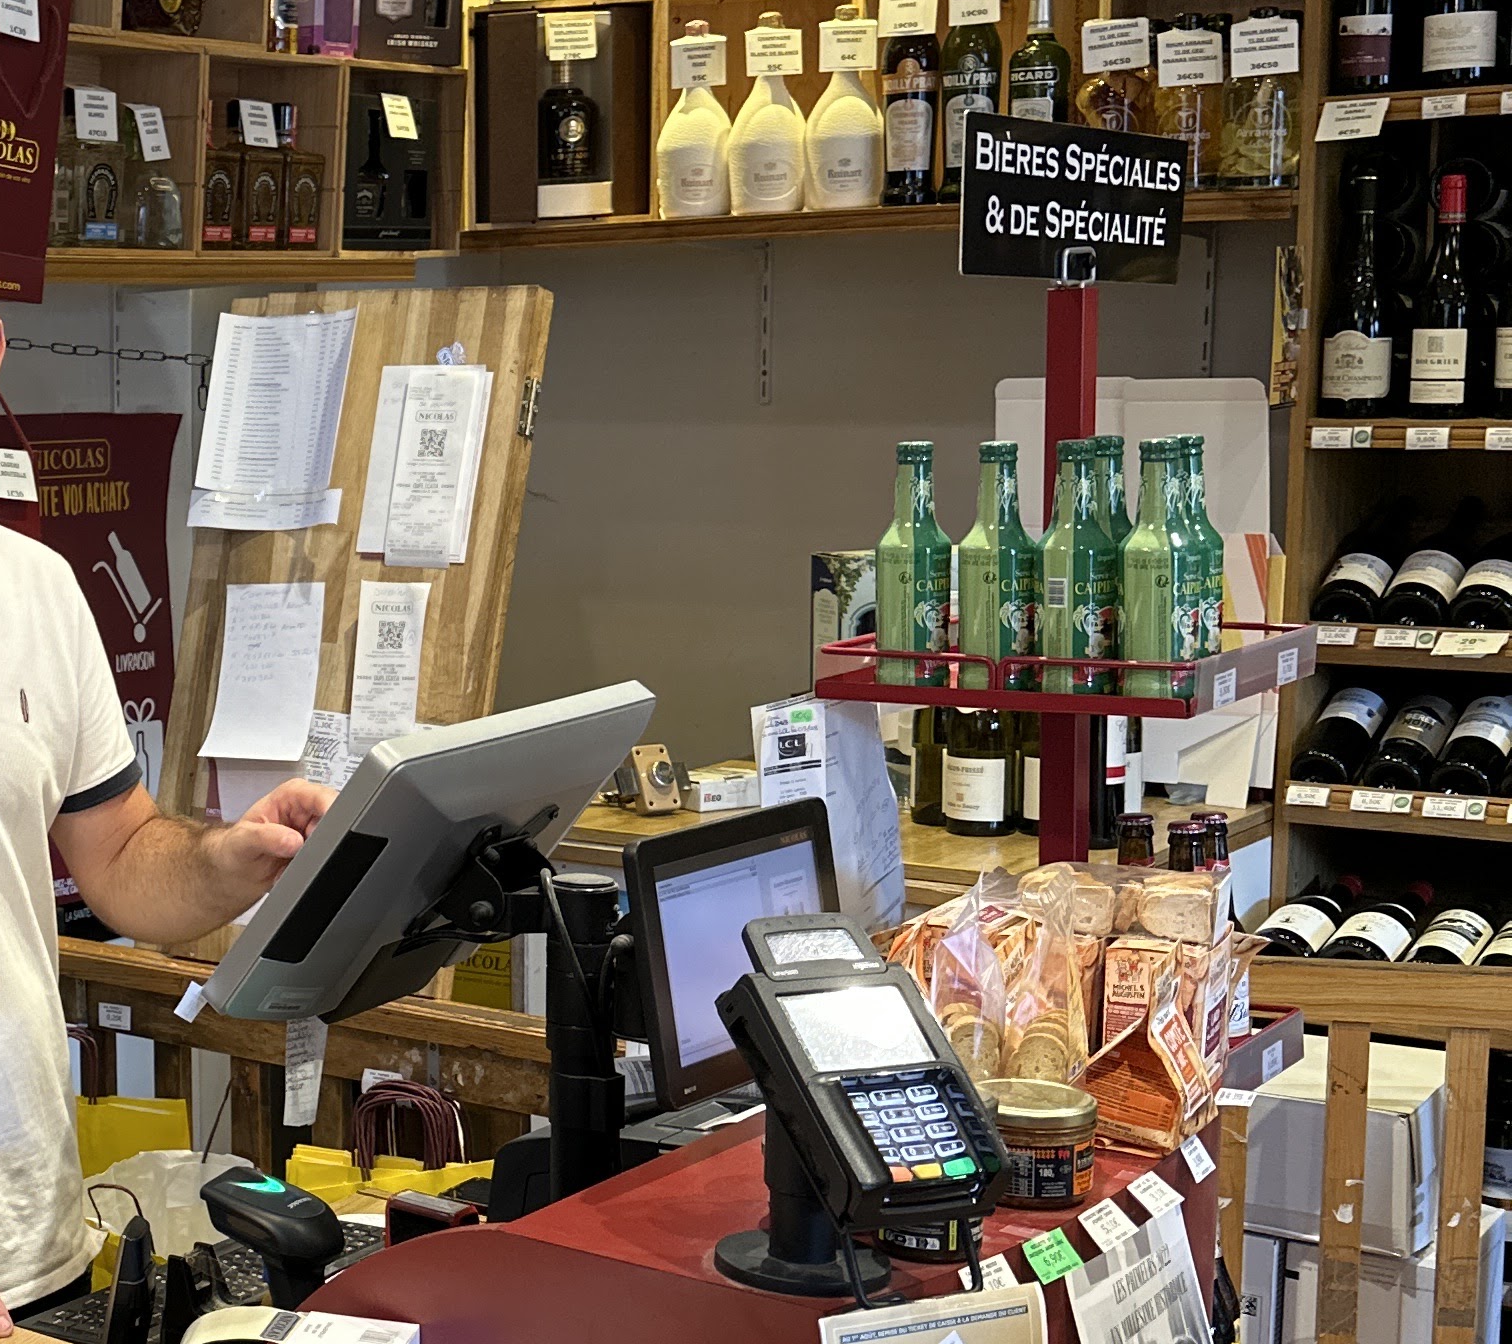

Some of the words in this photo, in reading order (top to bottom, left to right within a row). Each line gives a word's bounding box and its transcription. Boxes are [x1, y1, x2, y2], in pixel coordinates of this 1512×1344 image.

[975, 130, 1060, 179] BIÈRES
[1064, 143, 1182, 193] SPÉCIALES
[985, 194, 1004, 234] &
[1009, 203, 1040, 237] DE
[1045, 200, 1167, 246] SPÉCIALITÉ
[418, 411, 456, 422] NICOLAS
[62, 482, 84, 516] VOS
[87, 479, 131, 513] ACHATS
[375, 603, 411, 613] NICOLAS
[115, 650, 156, 674] LIVRAISON
[779, 737, 800, 750] LCL
